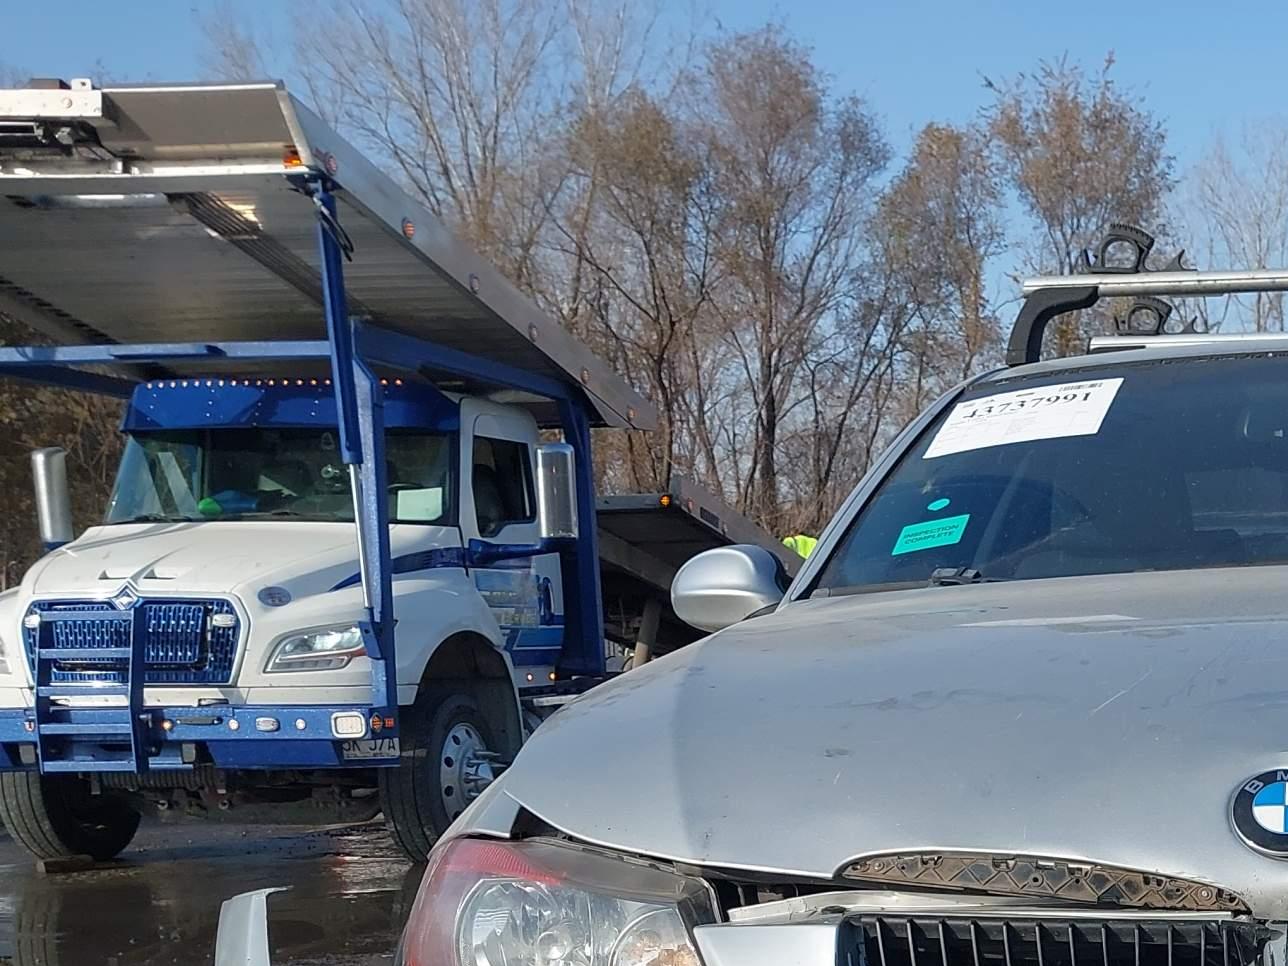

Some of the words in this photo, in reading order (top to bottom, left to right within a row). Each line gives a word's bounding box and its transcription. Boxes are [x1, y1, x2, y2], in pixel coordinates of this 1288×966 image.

[963, 391, 1093, 419] 43737991
[904, 524, 960, 539] INSPECTION
[904, 530, 956, 545] COMPLETE
